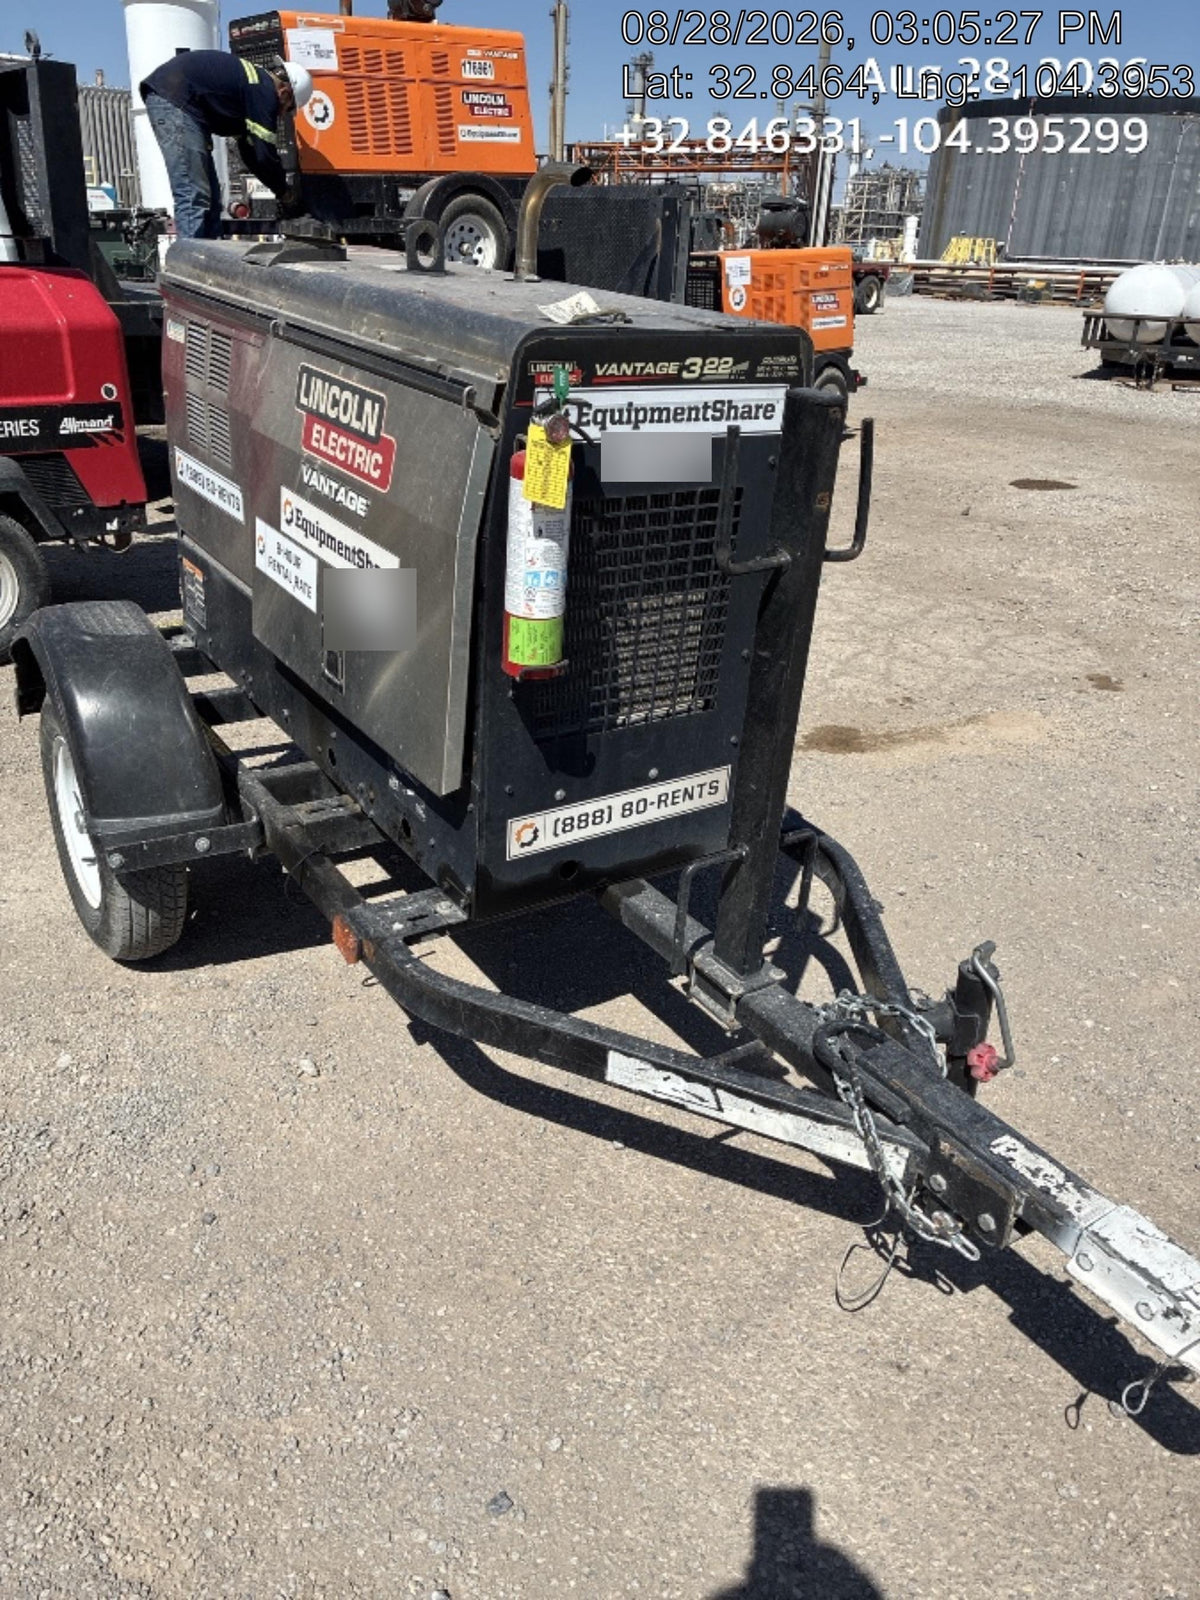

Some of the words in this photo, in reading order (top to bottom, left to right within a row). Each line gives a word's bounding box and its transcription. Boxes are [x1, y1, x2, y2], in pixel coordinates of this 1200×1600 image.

[463, 92, 506, 105] LINCOLN
[595, 361, 679, 377] VANTAGE
[681, 356, 734, 380] 322
[59, 416, 114, 434] Allmand
[299, 372, 381, 437] LINCOLN
[577, 399, 777, 431] EquipmentShare
[310, 422, 384, 479] ELECTRIC
[301, 464, 369, 518] VANTAGE
[267, 554, 293, 585] RENTAL
[294, 575, 313, 601] RATE
[551, 805, 613, 837] (888)
[620, 779, 721, 819] 80-RENTS
